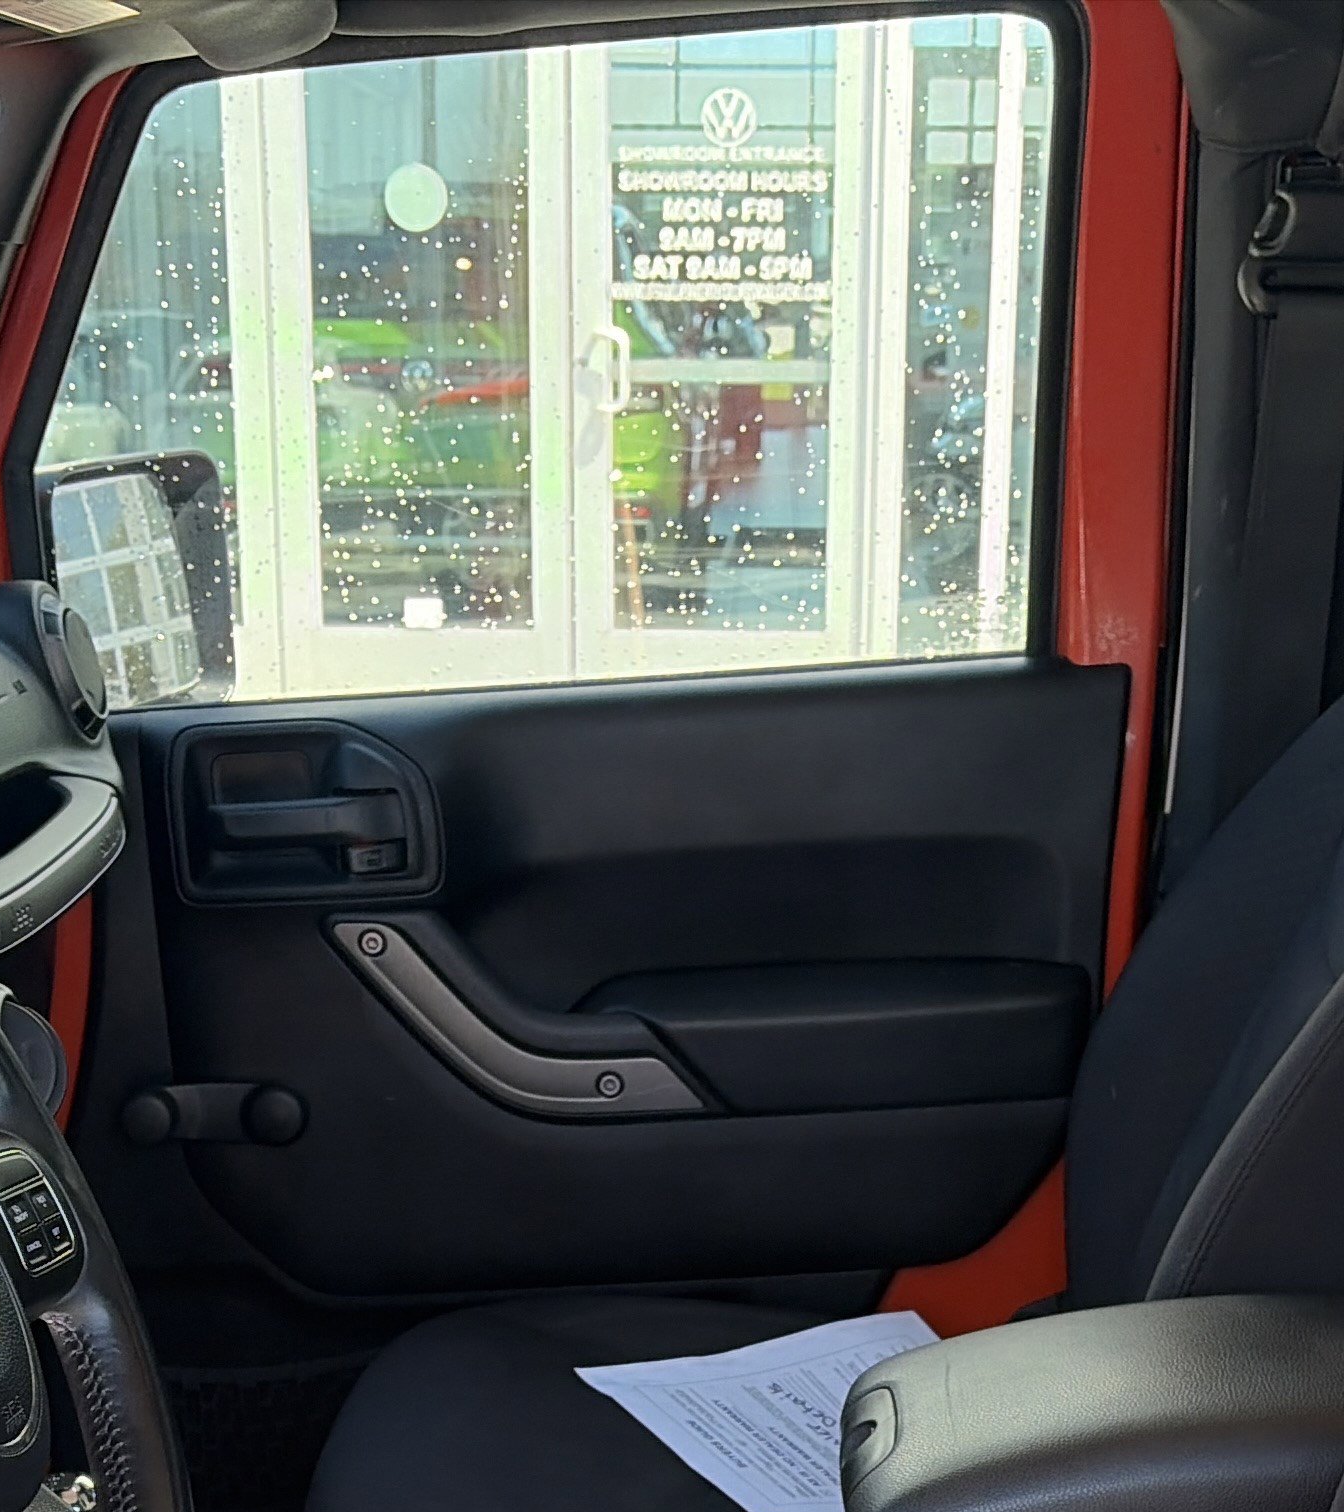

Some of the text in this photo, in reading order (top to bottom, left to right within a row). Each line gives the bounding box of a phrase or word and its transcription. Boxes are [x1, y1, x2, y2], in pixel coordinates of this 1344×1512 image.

[618, 169, 829, 192] SHOWROOM HOURS
[662, 197, 722, 222] MON
[741, 197, 784, 222] FRI
[730, 226, 786, 252] 7PM
[633, 254, 684, 280] SAT
